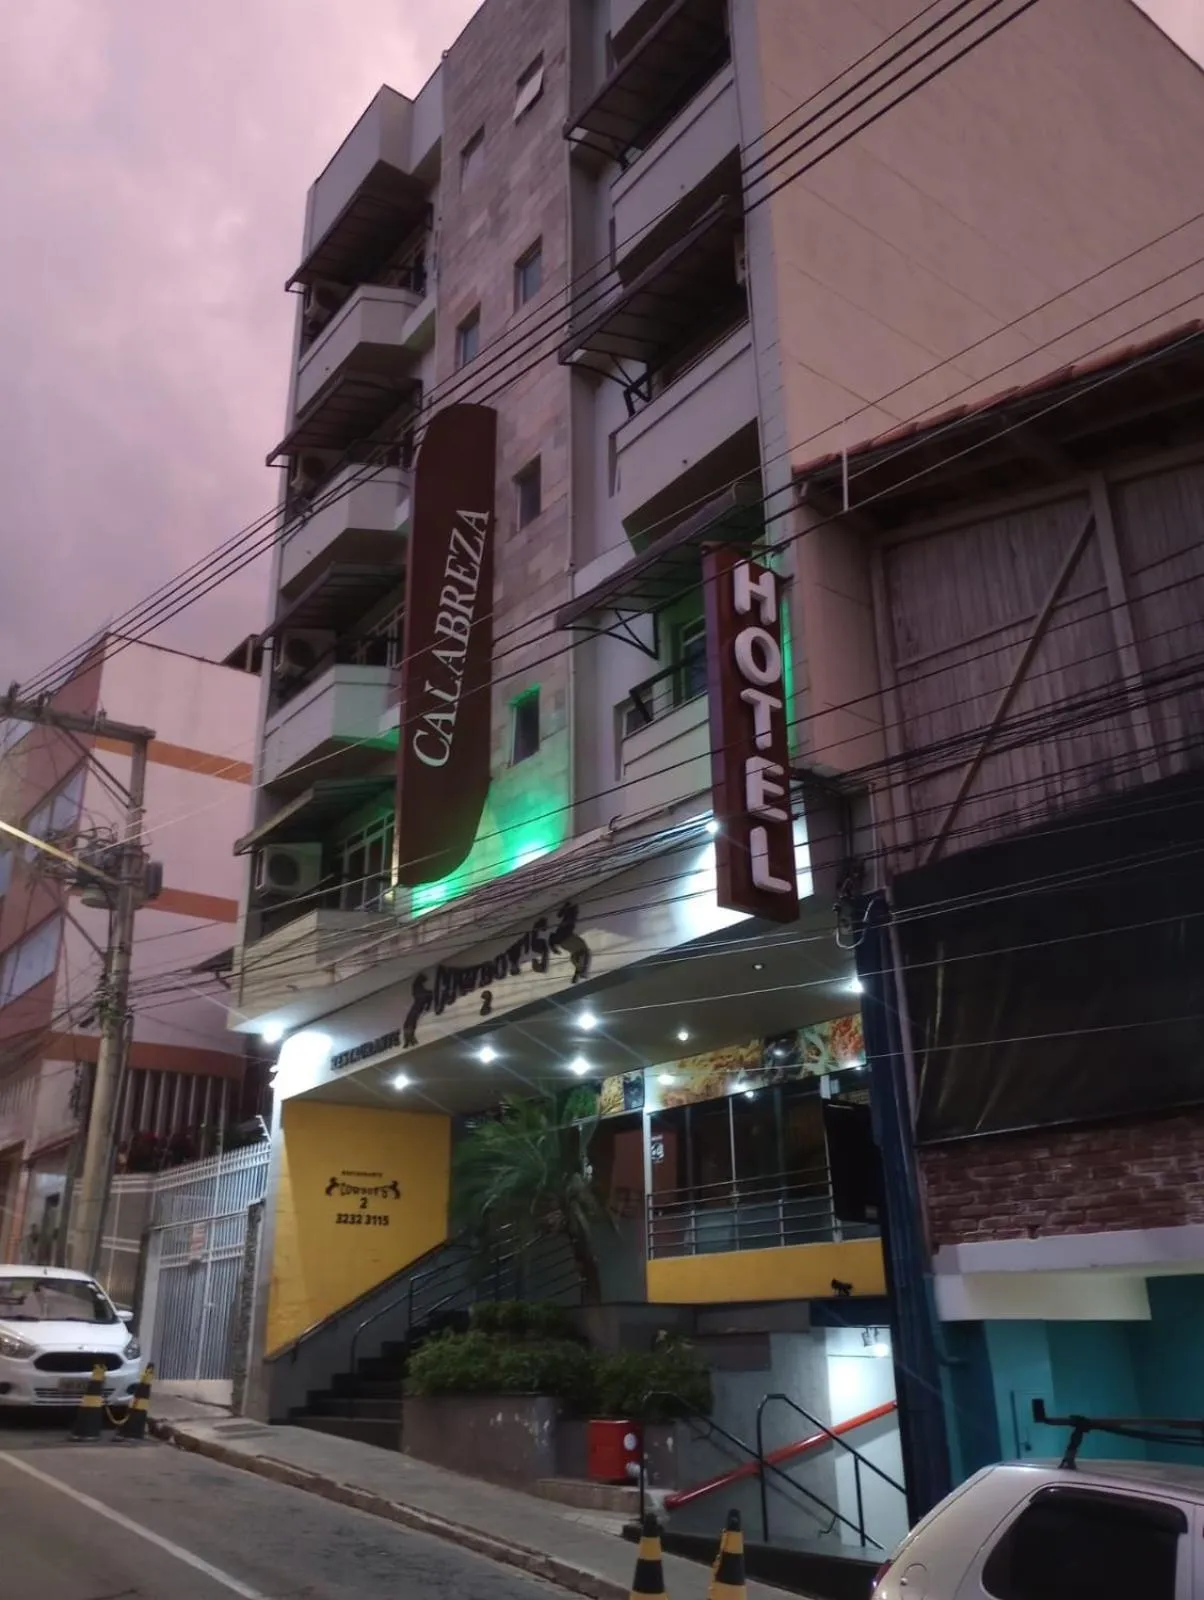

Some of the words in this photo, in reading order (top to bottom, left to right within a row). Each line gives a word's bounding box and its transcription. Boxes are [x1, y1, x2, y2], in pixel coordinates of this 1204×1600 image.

[412, 509, 490, 768] CALABREZA
[733, 558, 792, 893] HOTEL
[479, 989, 493, 1016] 2
[359, 1196, 368, 1209] 2
